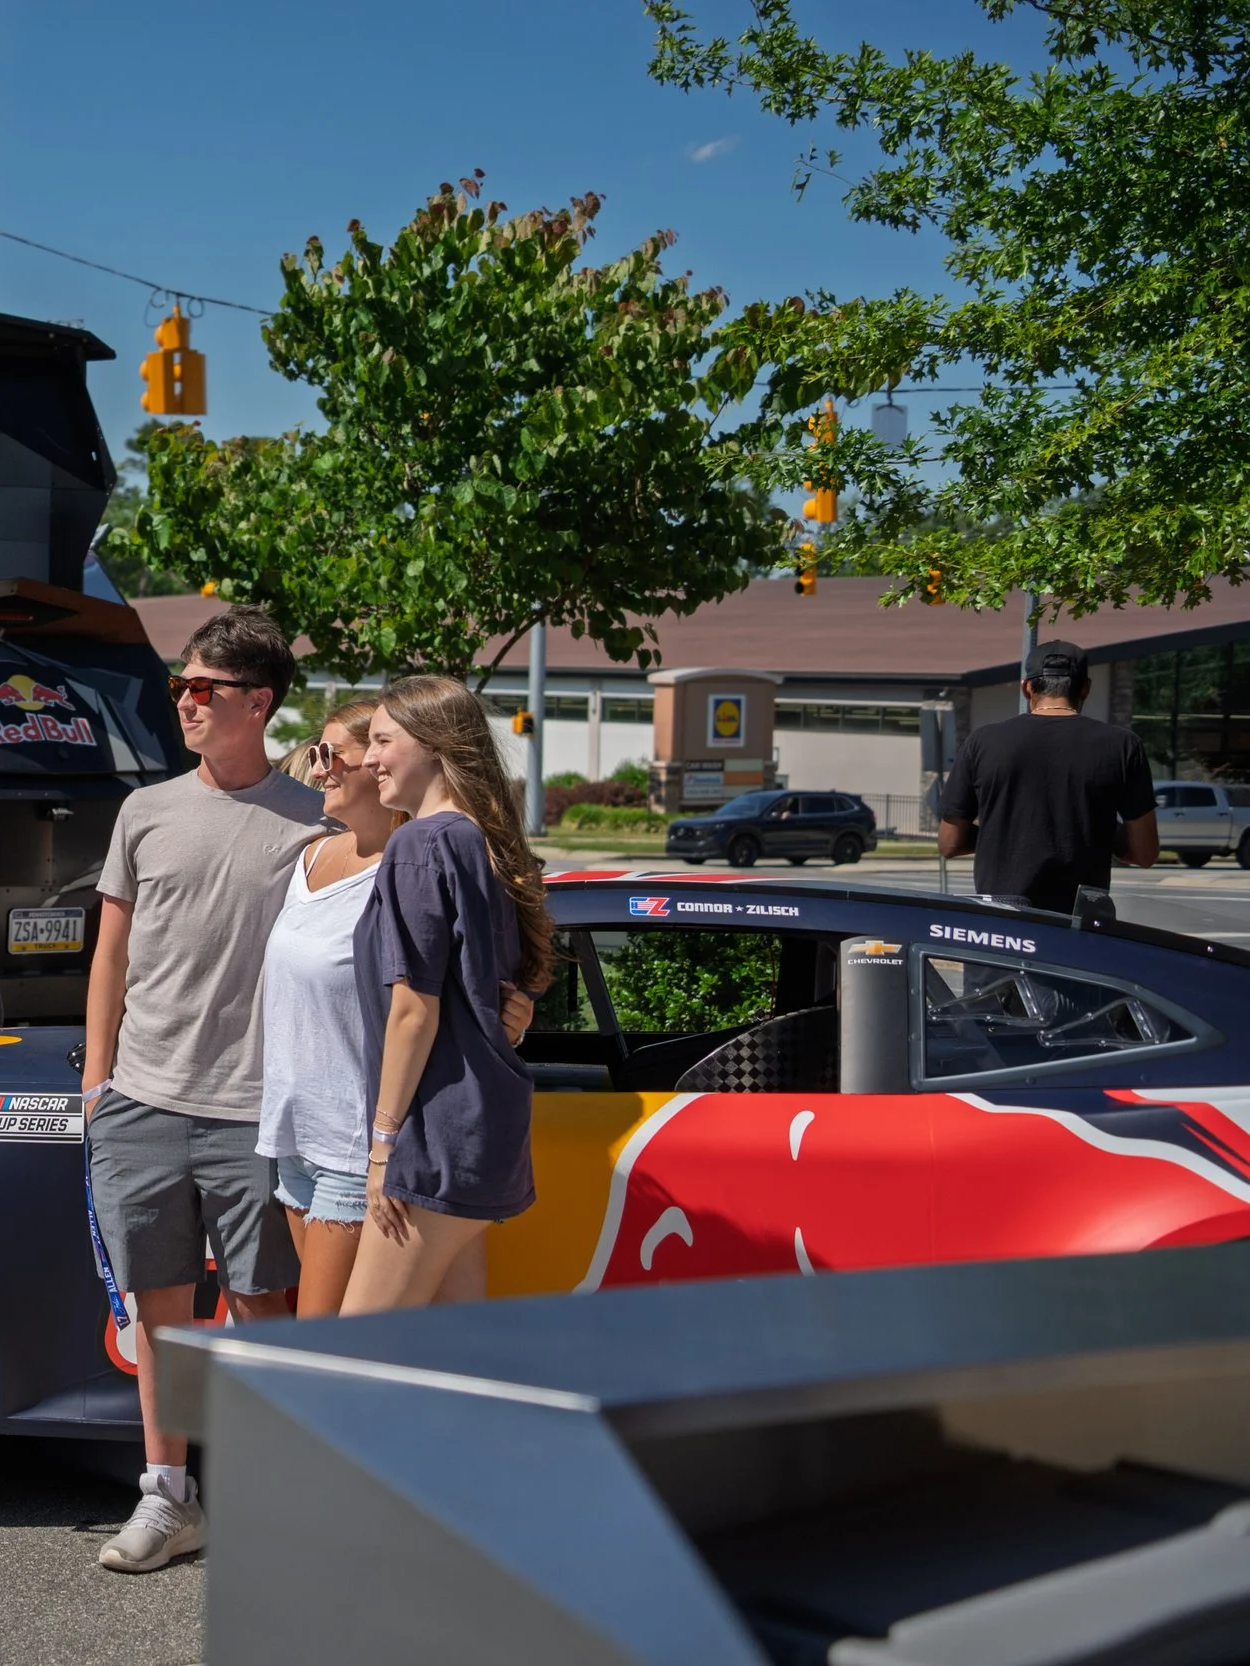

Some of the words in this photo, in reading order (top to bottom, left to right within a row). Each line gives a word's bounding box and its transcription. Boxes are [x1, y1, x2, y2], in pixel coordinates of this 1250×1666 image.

[38, 714, 97, 746] Bull
[677, 902, 733, 913] CONNOR
[746, 904, 799, 917] ZILISCH
[929, 924, 1036, 953] SIEMENS
[8, 1097, 69, 1111] NASCAR
[18, 1118, 69, 1132] SERIES
[103, 1266, 118, 1293] ALLEN
